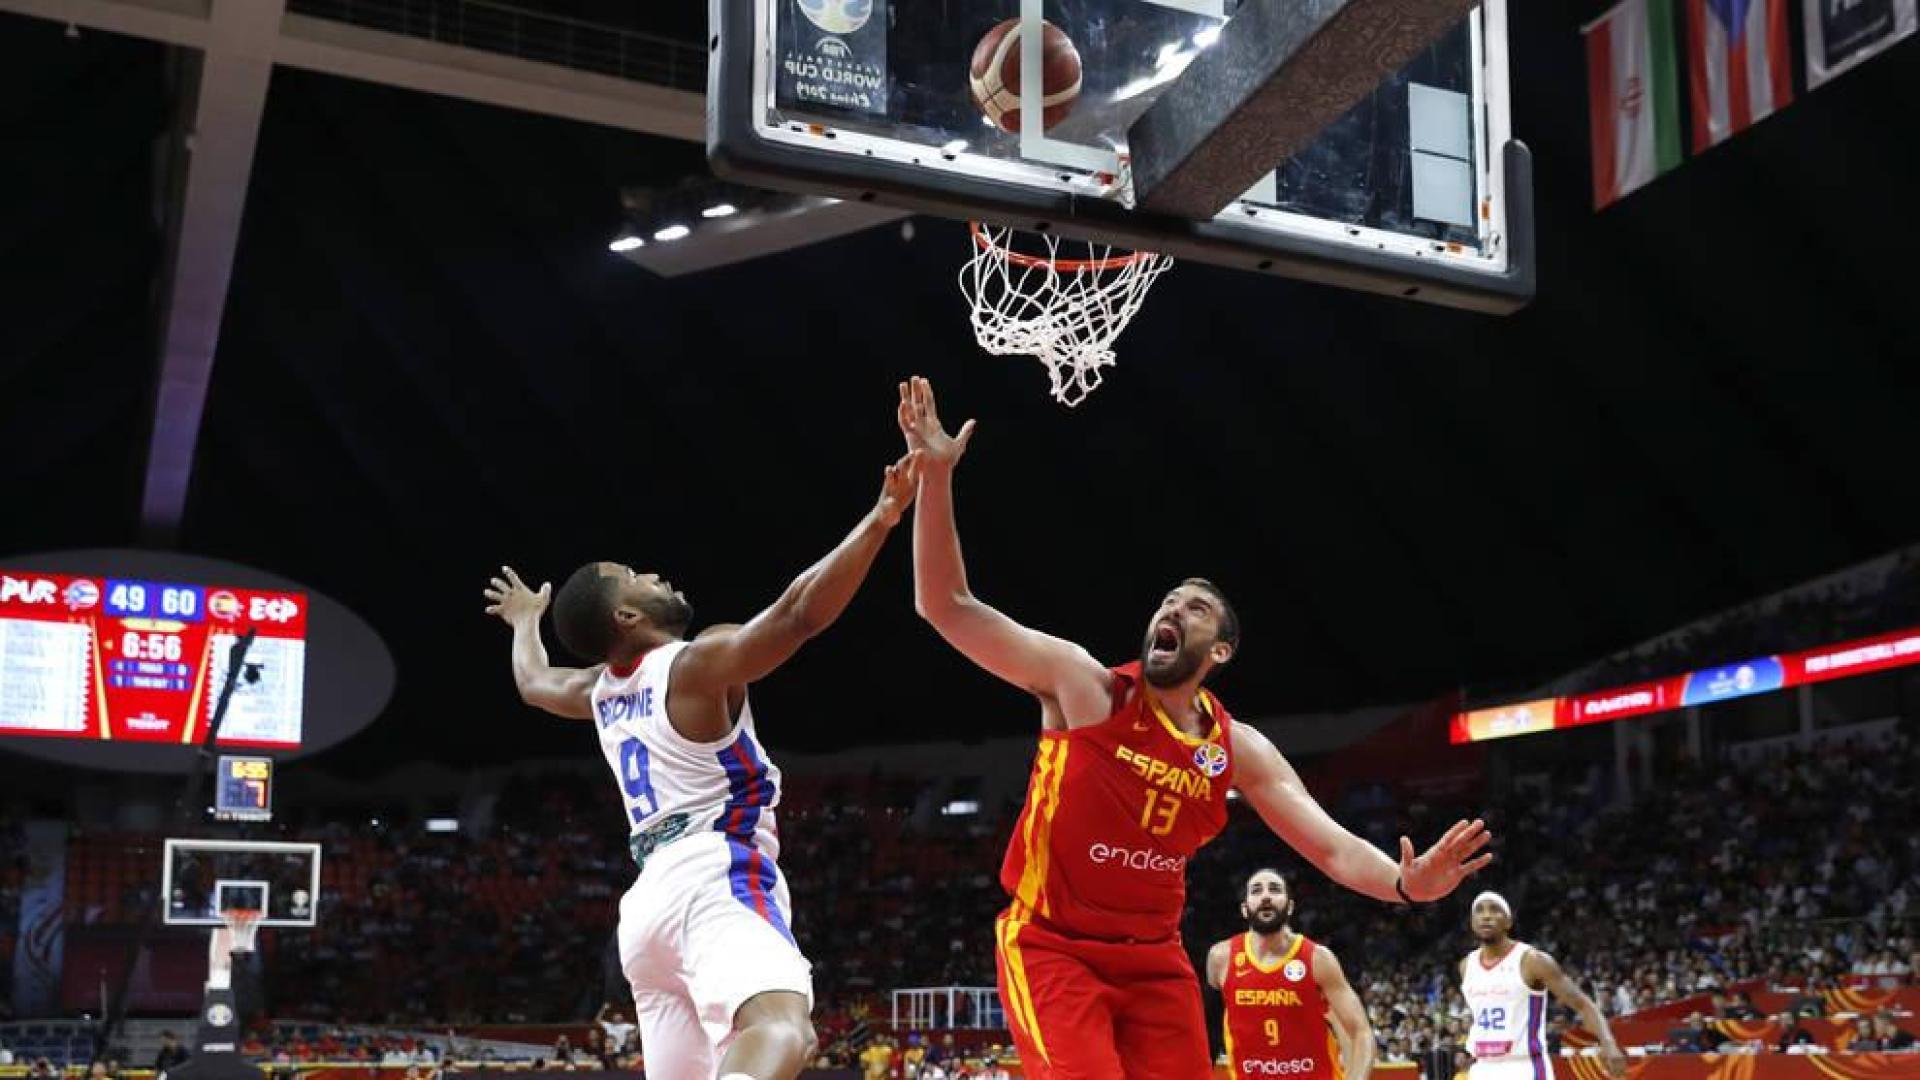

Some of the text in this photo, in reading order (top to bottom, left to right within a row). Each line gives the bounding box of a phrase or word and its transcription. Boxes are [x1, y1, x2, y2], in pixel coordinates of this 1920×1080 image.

[1, 575, 58, 604] PUR
[110, 584, 197, 616] 49 60
[121, 631, 183, 662] 6:56
[620, 736, 659, 825] 9
[1114, 744, 1212, 802] ESPAÑA
[1140, 788, 1182, 835] 13
[1235, 988, 1304, 1007] ESPAÑA
[1263, 1018, 1280, 1047] 9
[1477, 1007, 1506, 1031] 42
[1242, 1057, 1314, 1075] endesa
